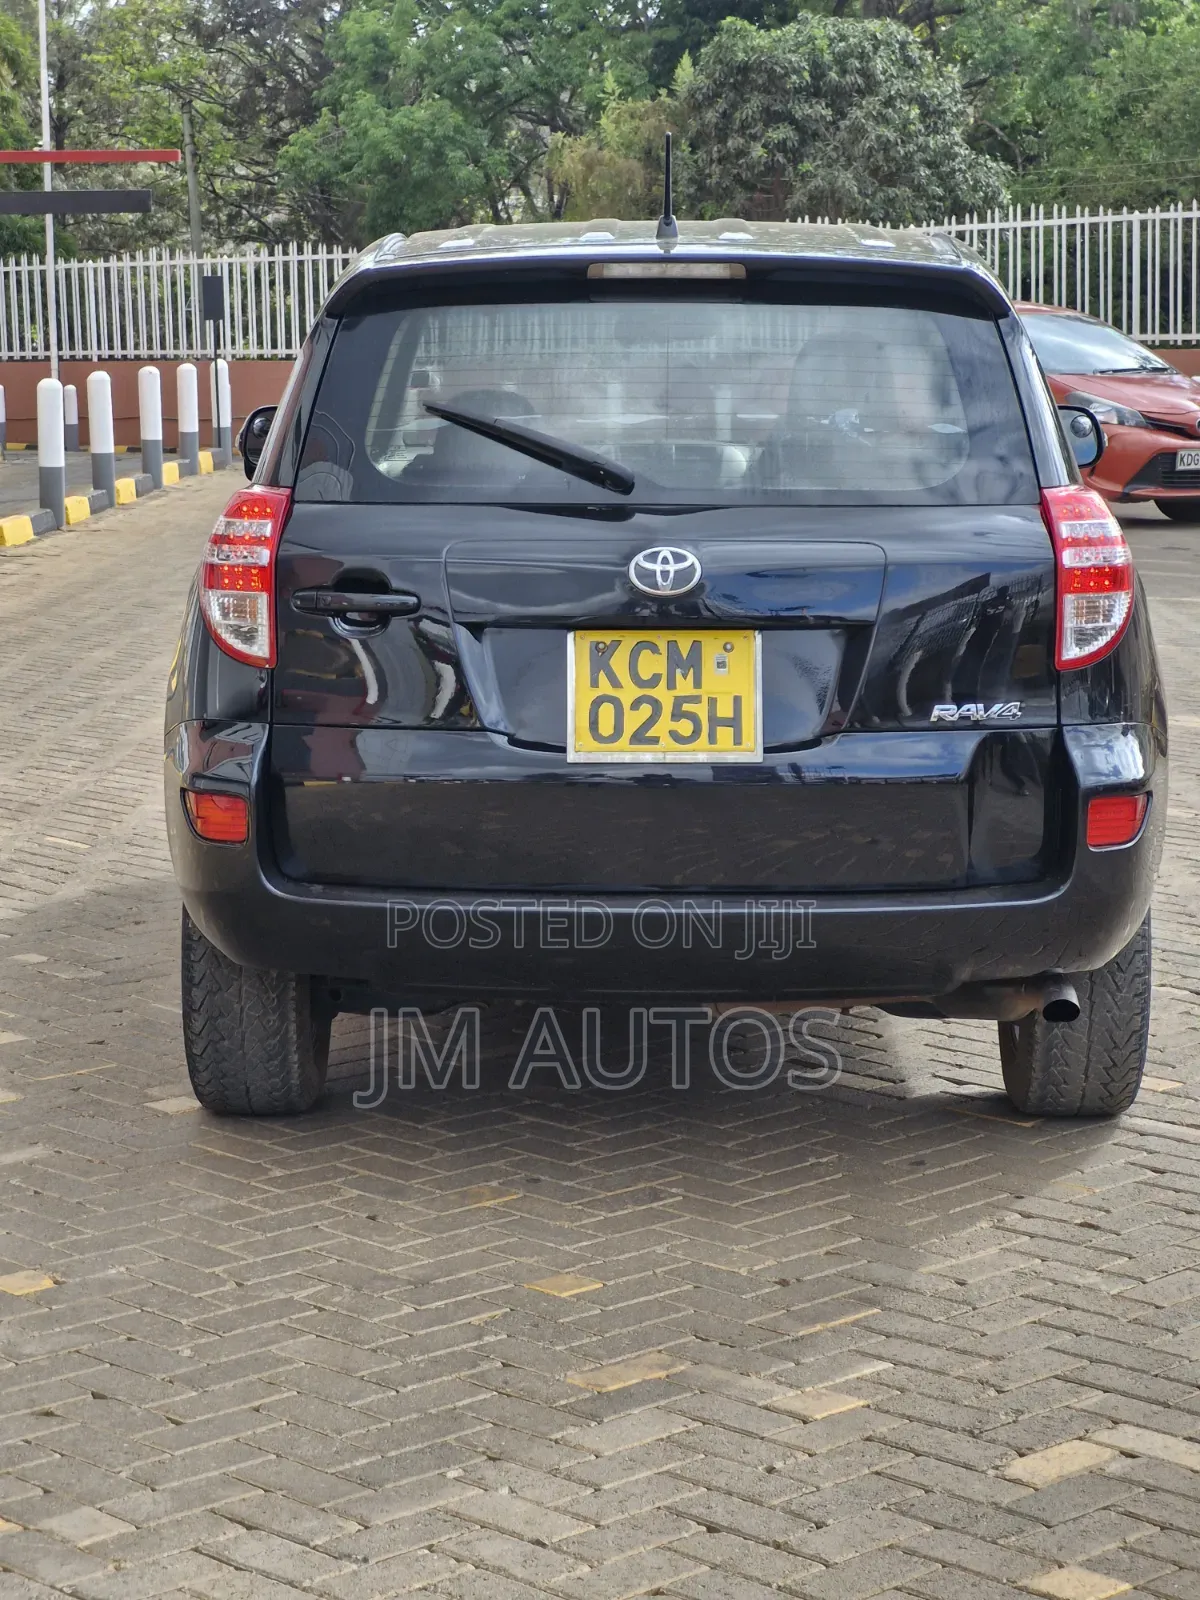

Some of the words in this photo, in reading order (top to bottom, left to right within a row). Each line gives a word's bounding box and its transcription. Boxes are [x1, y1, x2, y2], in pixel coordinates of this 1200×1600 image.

[1179, 453, 1200, 466] KDG
[589, 639, 703, 690] KCM
[588, 693, 743, 746] 025H
[929, 702, 1022, 722] RAV4
